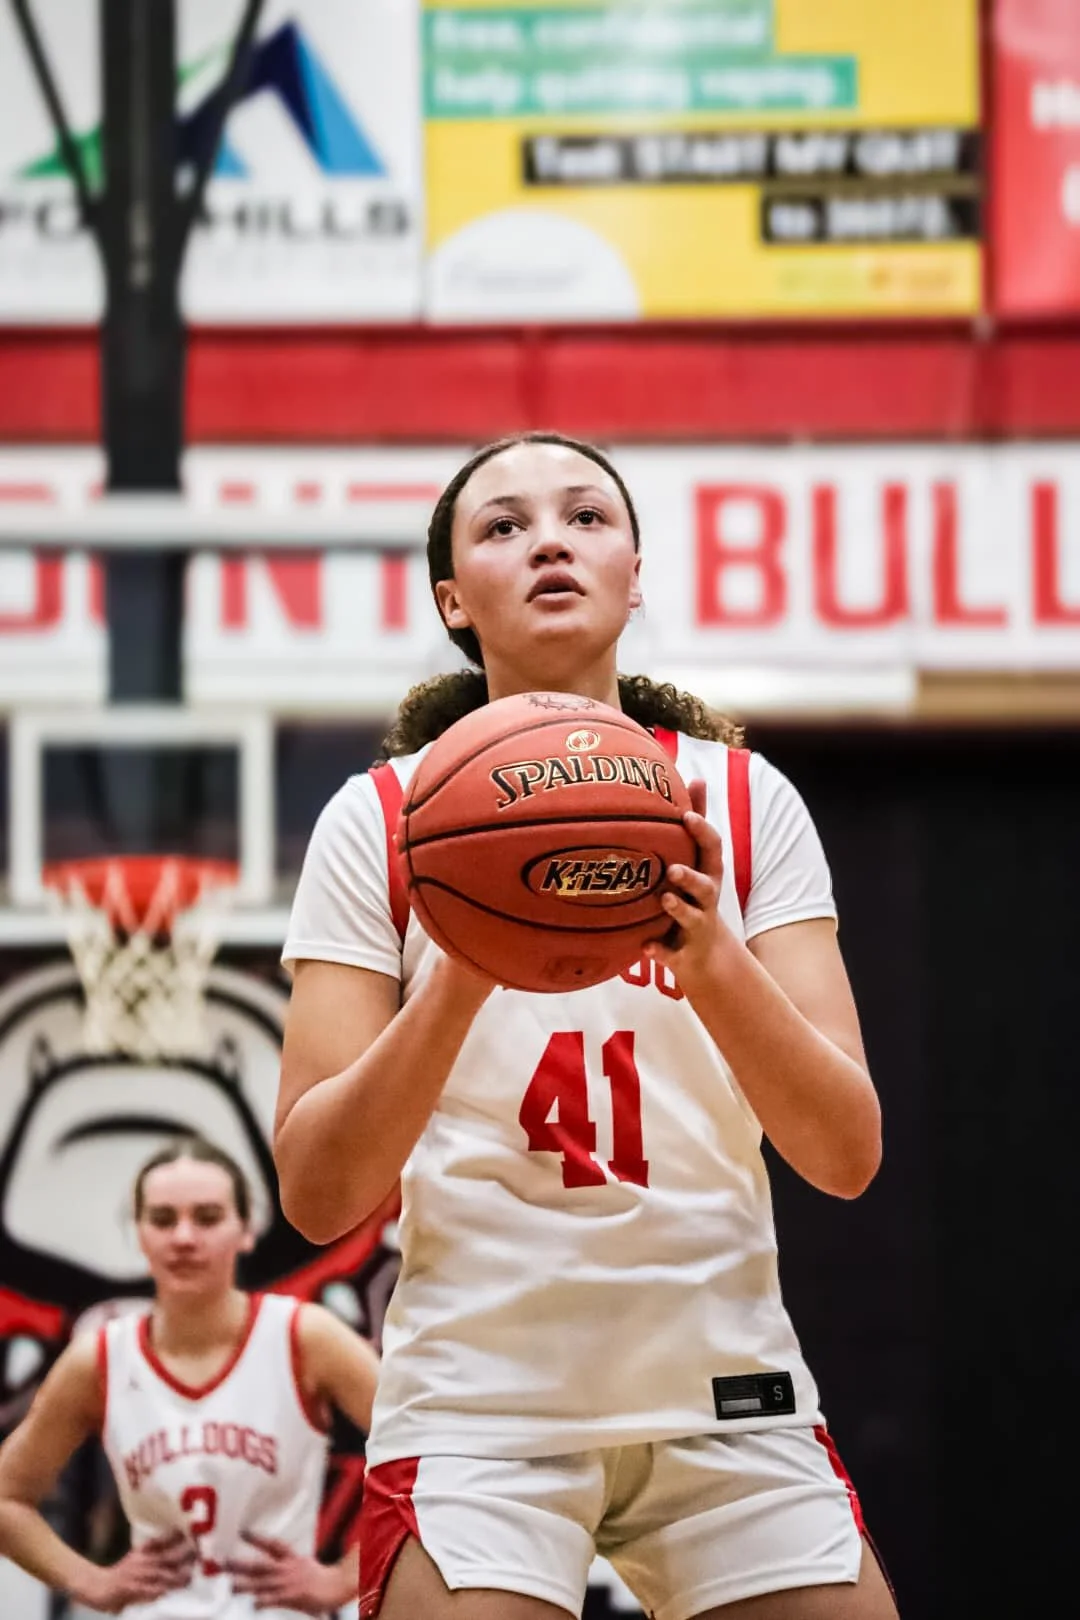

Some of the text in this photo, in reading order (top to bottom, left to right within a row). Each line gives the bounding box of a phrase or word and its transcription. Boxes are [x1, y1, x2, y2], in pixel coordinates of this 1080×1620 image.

[634, 133, 768, 176] START
[774, 131, 848, 175] MY
[855, 130, 961, 174] QUIT
[694, 481, 1080, 629] BULL
[490, 755, 678, 811] SPALDING
[540, 858, 651, 893] KHSAA
[519, 1031, 649, 1188] 41
[773, 1385, 784, 1401] S
[124, 1421, 278, 1492] BULLDOGS
